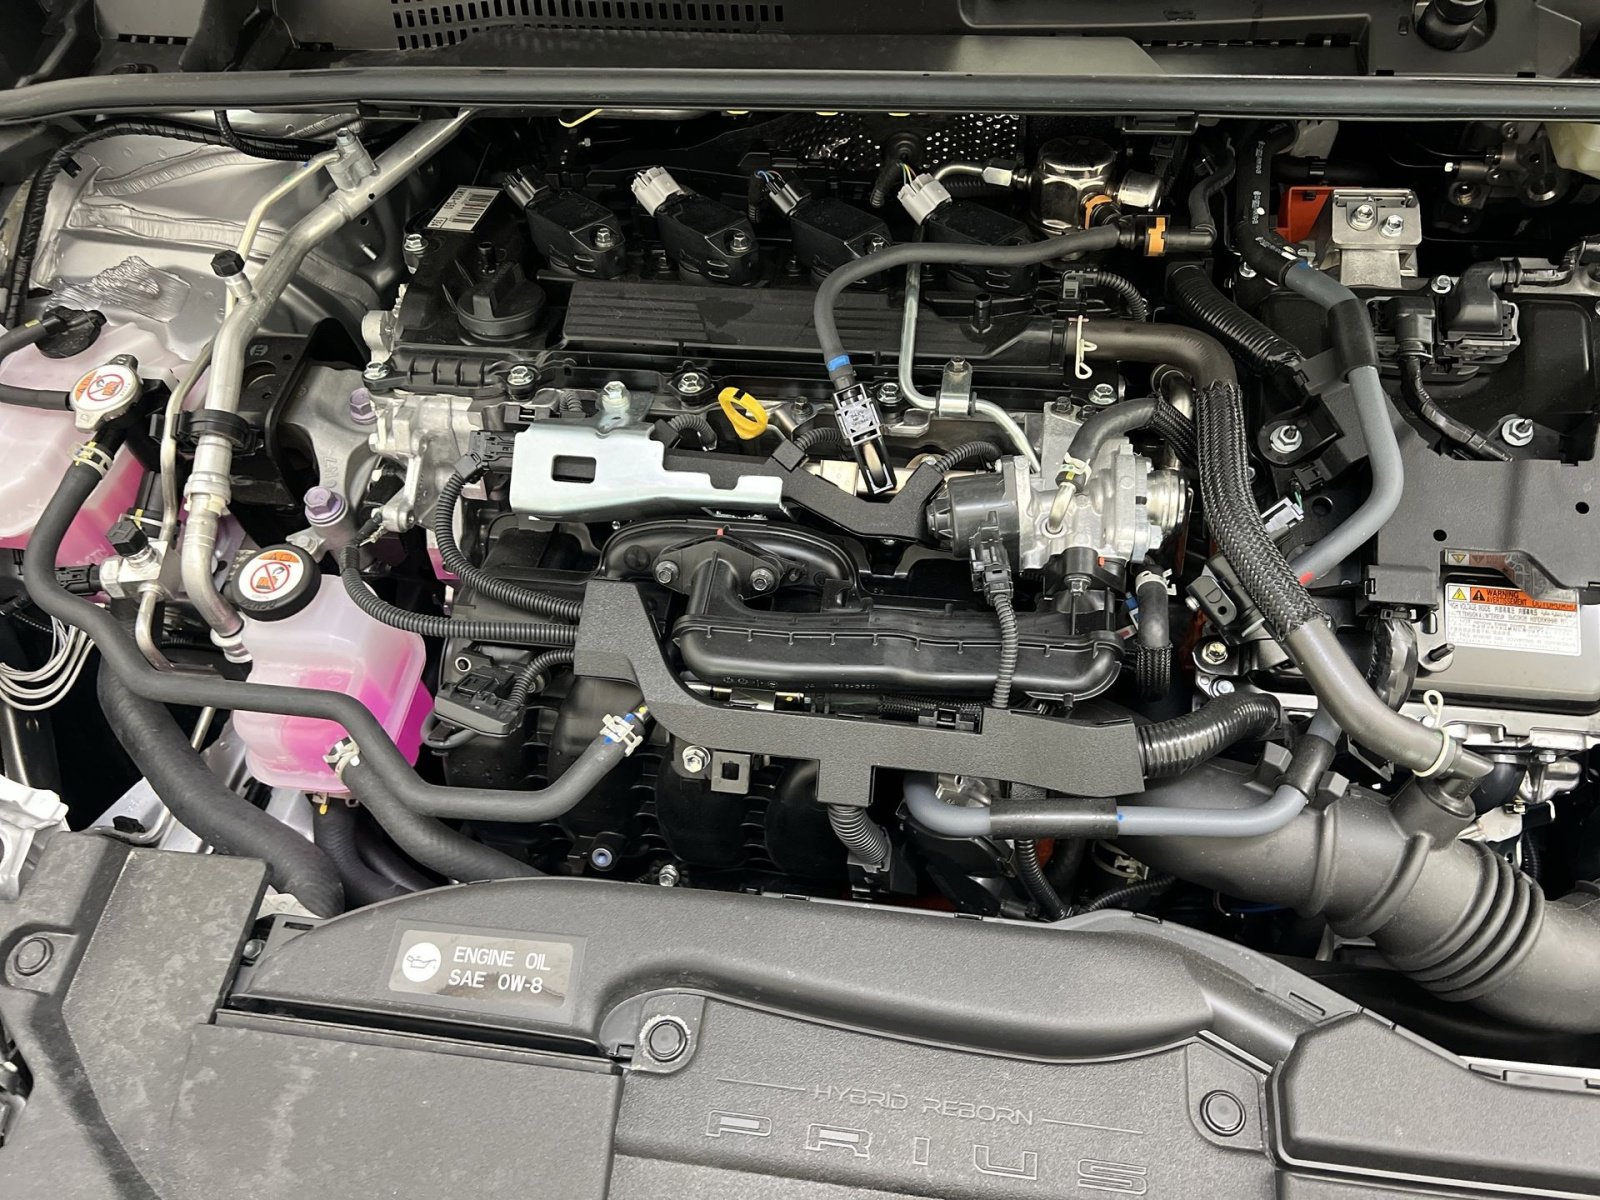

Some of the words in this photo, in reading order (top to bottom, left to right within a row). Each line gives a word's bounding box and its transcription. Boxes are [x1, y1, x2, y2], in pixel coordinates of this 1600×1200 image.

[1486, 589, 1519, 599] WARNING
[453, 946, 515, 967] ENGINE
[525, 953, 552, 971] OIL
[448, 969, 487, 988] SAE
[813, 1084, 908, 1111] HYBRID
[922, 1099, 1034, 1126] REBORN
[705, 1109, 1148, 1195] PRIUS
